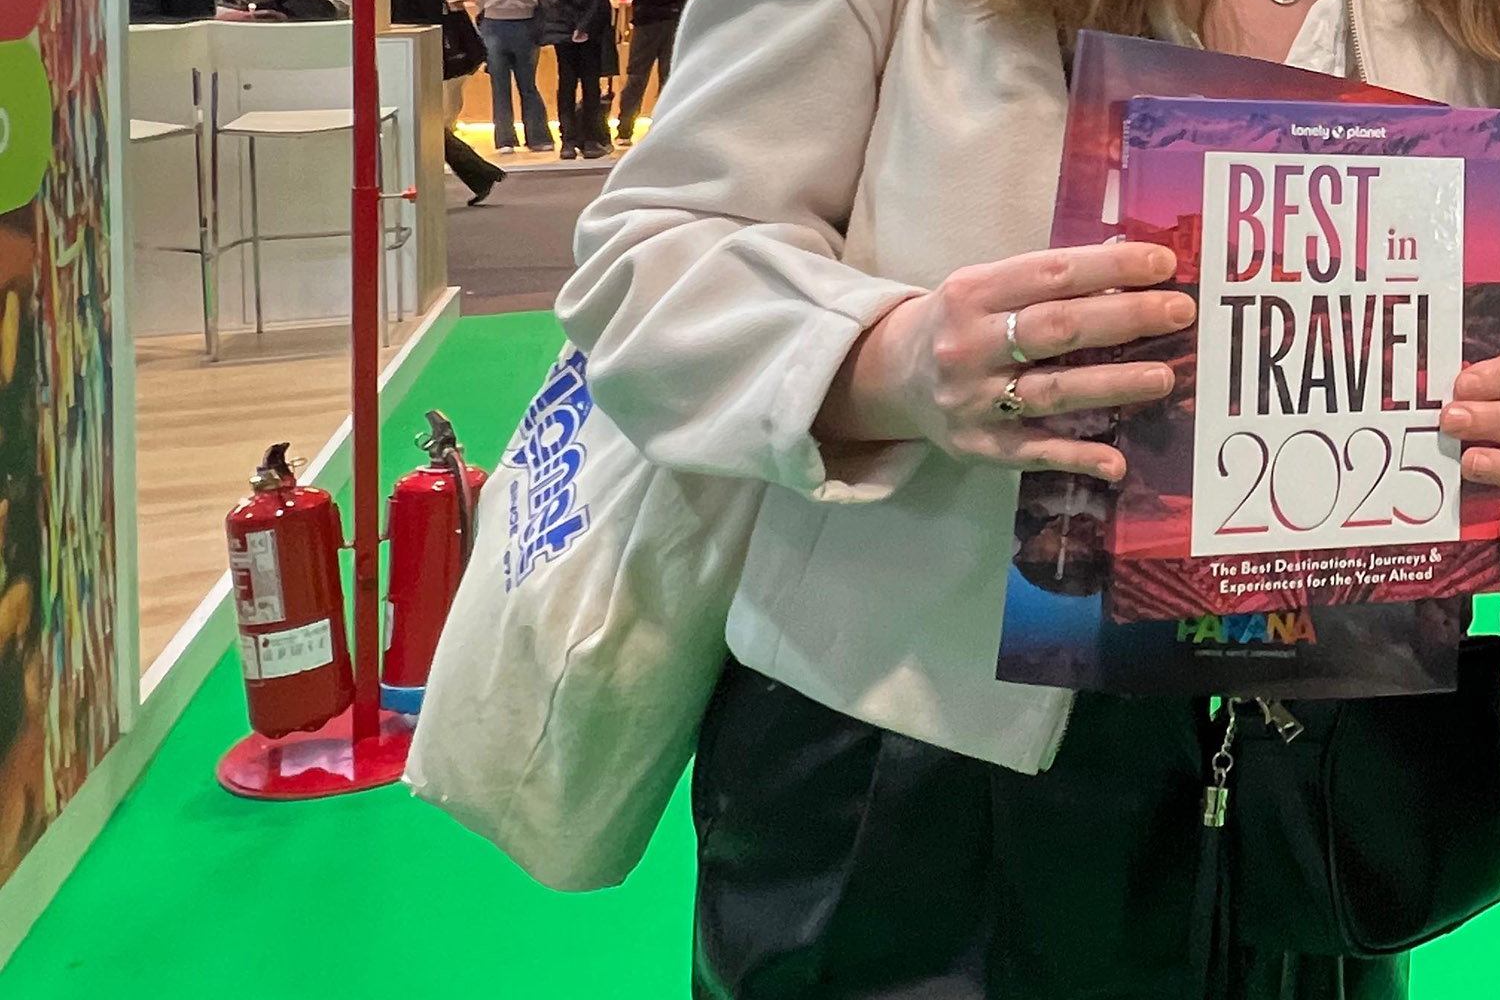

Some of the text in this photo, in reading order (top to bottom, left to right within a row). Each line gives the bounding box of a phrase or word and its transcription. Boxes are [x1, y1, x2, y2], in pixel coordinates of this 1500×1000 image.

[1291, 123, 1386, 140] lonely planet
[1226, 163, 1417, 283] BEST in
[1220, 295, 1443, 416] TRAVEL
[1214, 427, 1445, 535] 2025
[1210, 547, 1442, 577] The Best Destinations, Journeys &
[1220, 567, 1433, 596] Experiences for the Year Ahead
